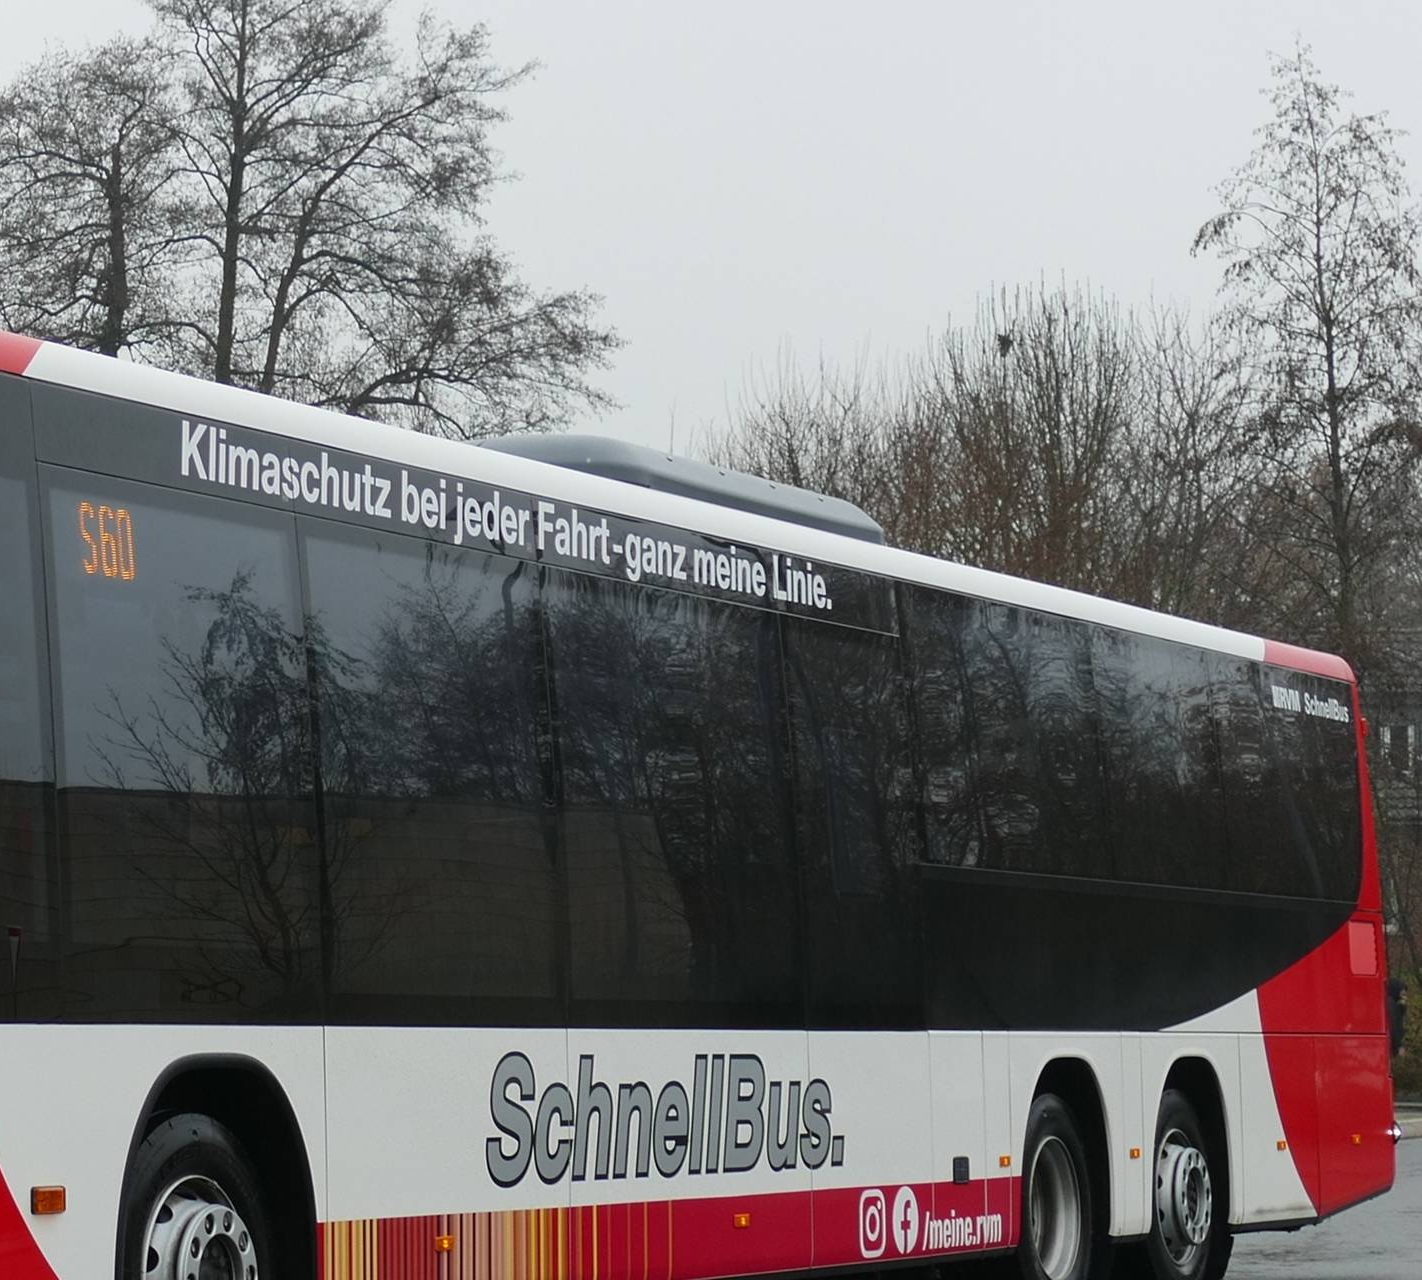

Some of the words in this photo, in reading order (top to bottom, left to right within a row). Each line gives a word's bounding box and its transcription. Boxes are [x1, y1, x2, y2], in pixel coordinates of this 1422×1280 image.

[80, 502, 135, 580] S60
[180, 420, 391, 519] Klimaschutz
[400, 470, 447, 529] bei
[454, 482, 530, 546] jeder
[692, 545, 766, 597] meine
[772, 554, 833, 610] Linie.
[485, 1051, 845, 1188] SchnellBus.
